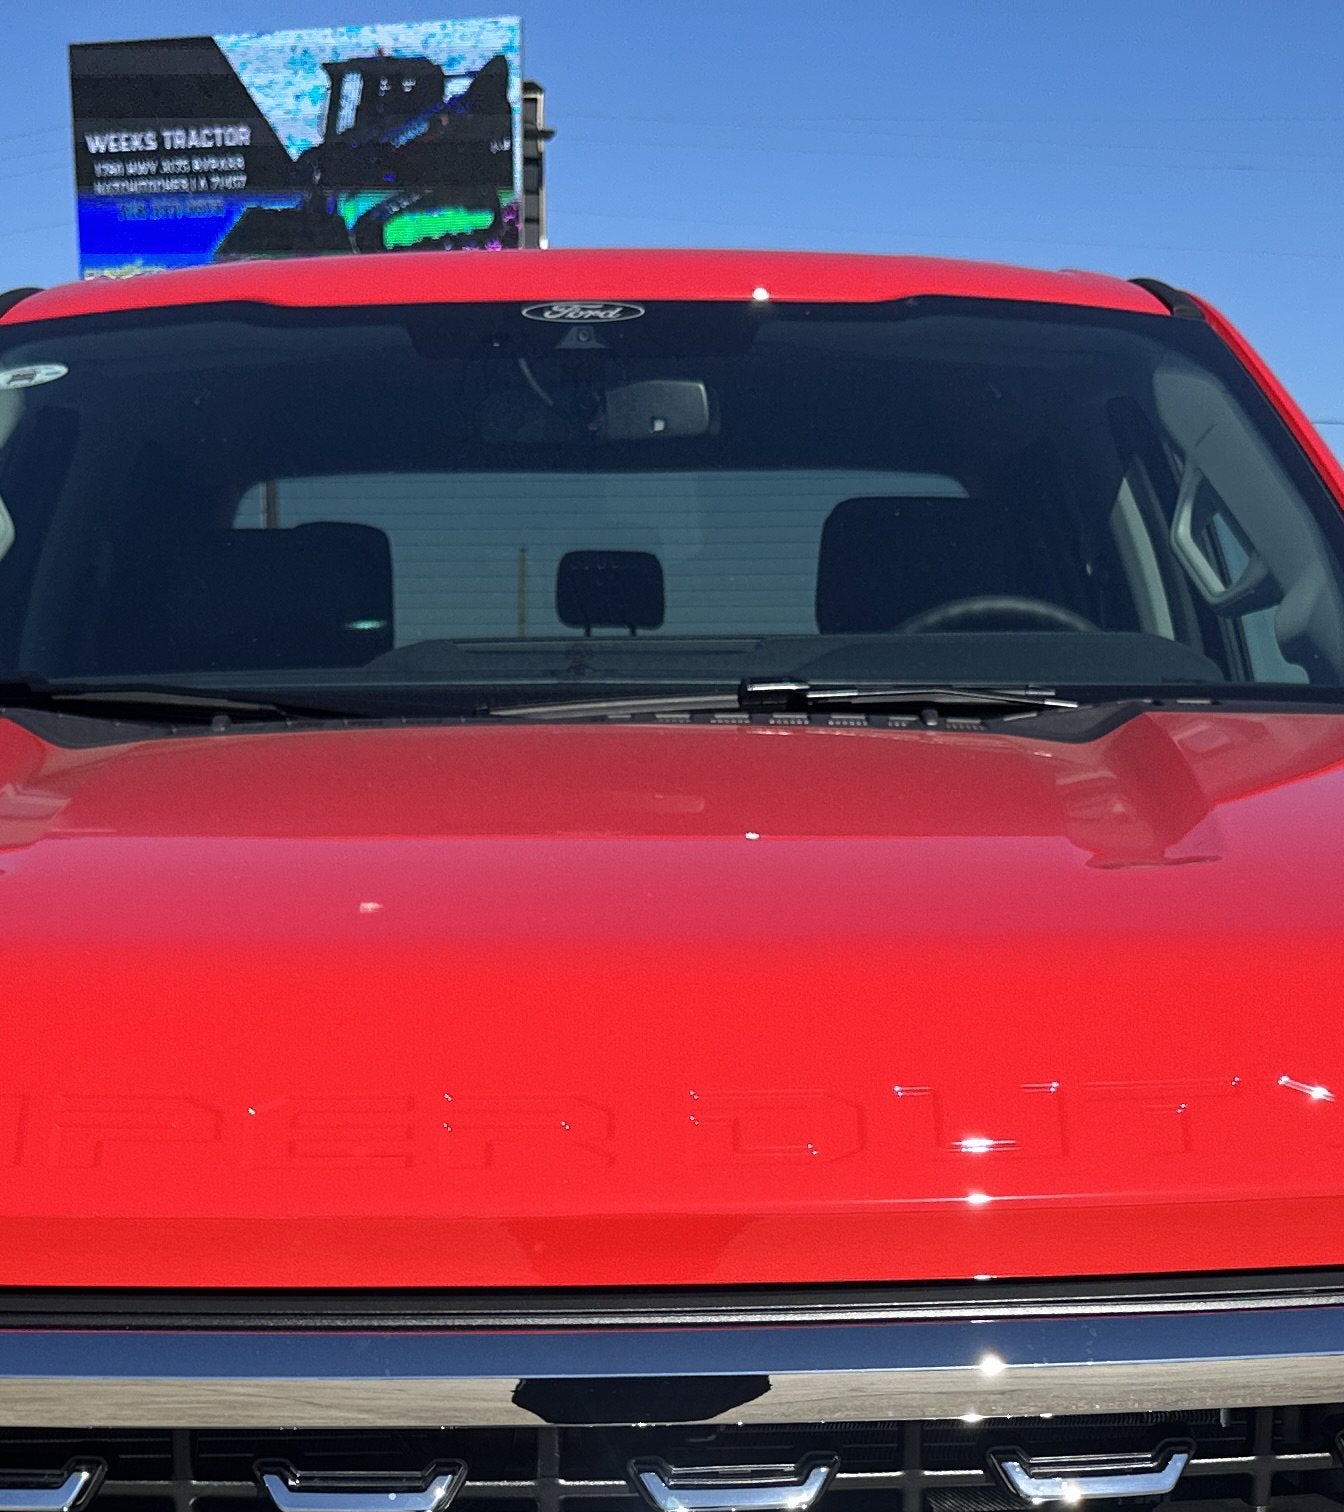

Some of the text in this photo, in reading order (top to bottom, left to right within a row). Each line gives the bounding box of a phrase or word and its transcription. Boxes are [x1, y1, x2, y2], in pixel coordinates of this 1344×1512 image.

[85, 125, 251, 153] WEEKS TRACTOR
[544, 304, 623, 319] Ford
